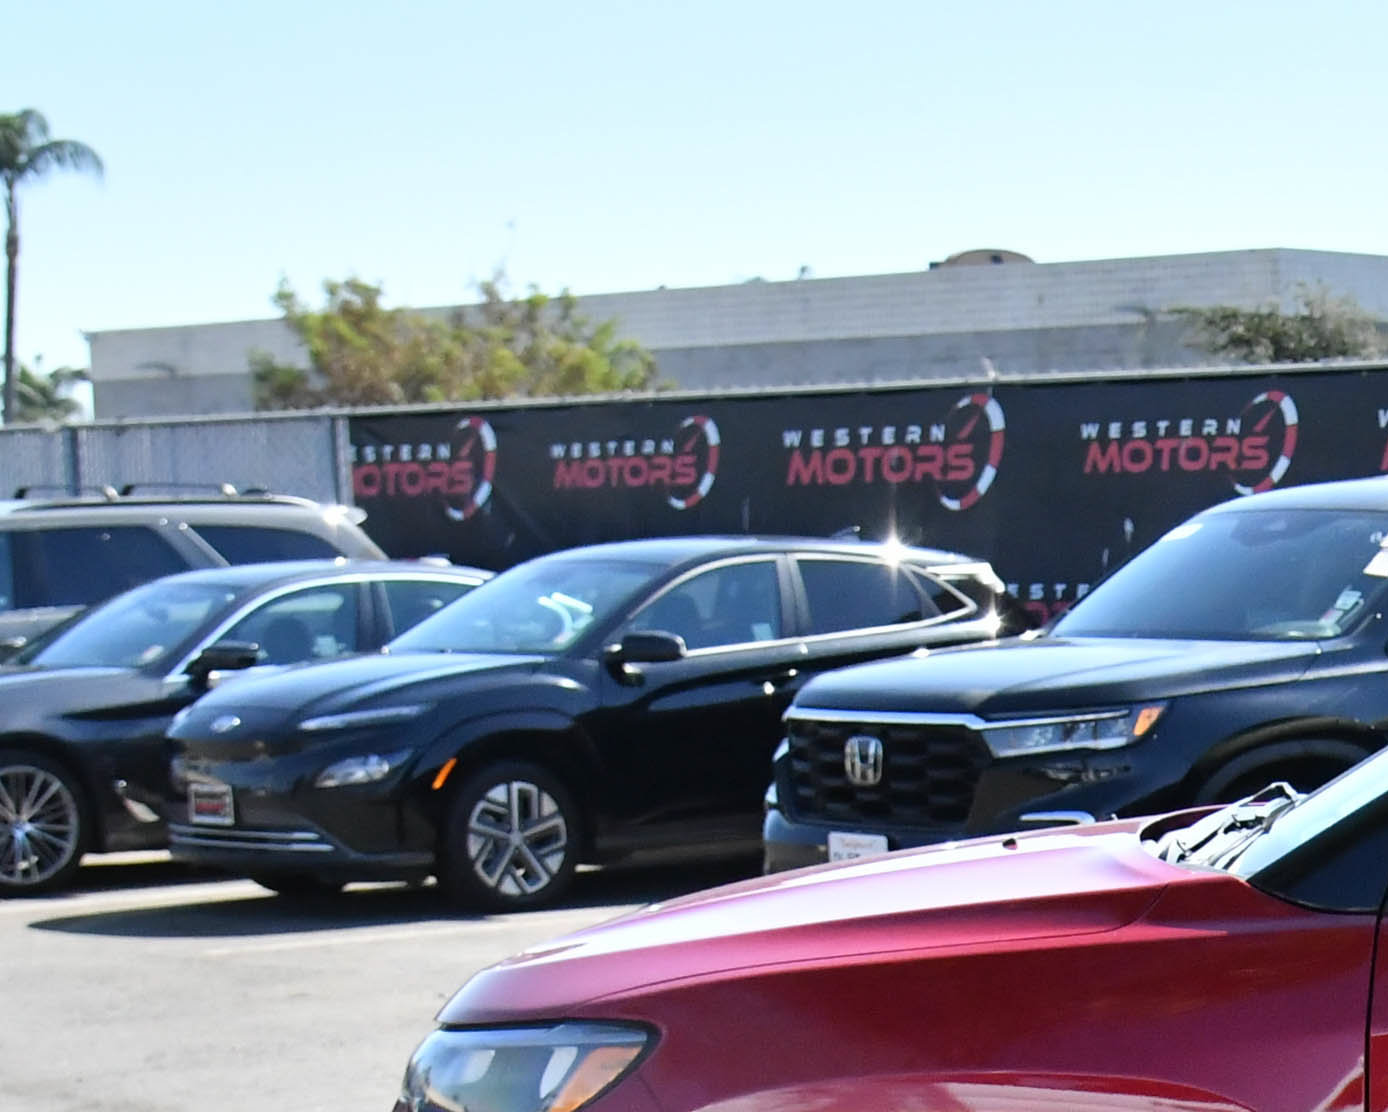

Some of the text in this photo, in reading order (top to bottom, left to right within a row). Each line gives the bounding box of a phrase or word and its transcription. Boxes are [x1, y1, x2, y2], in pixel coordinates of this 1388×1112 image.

[783, 423, 946, 448] WESTERN
[1081, 418, 1242, 440] WESTERN
[349, 443, 451, 463] ESTERN
[549, 439, 675, 460] WESTERN
[1082, 435, 1272, 475] MOTORS
[353, 460, 473, 498] OTORS
[552, 454, 698, 490] MOTORS
[785, 443, 977, 487] MOTORS
